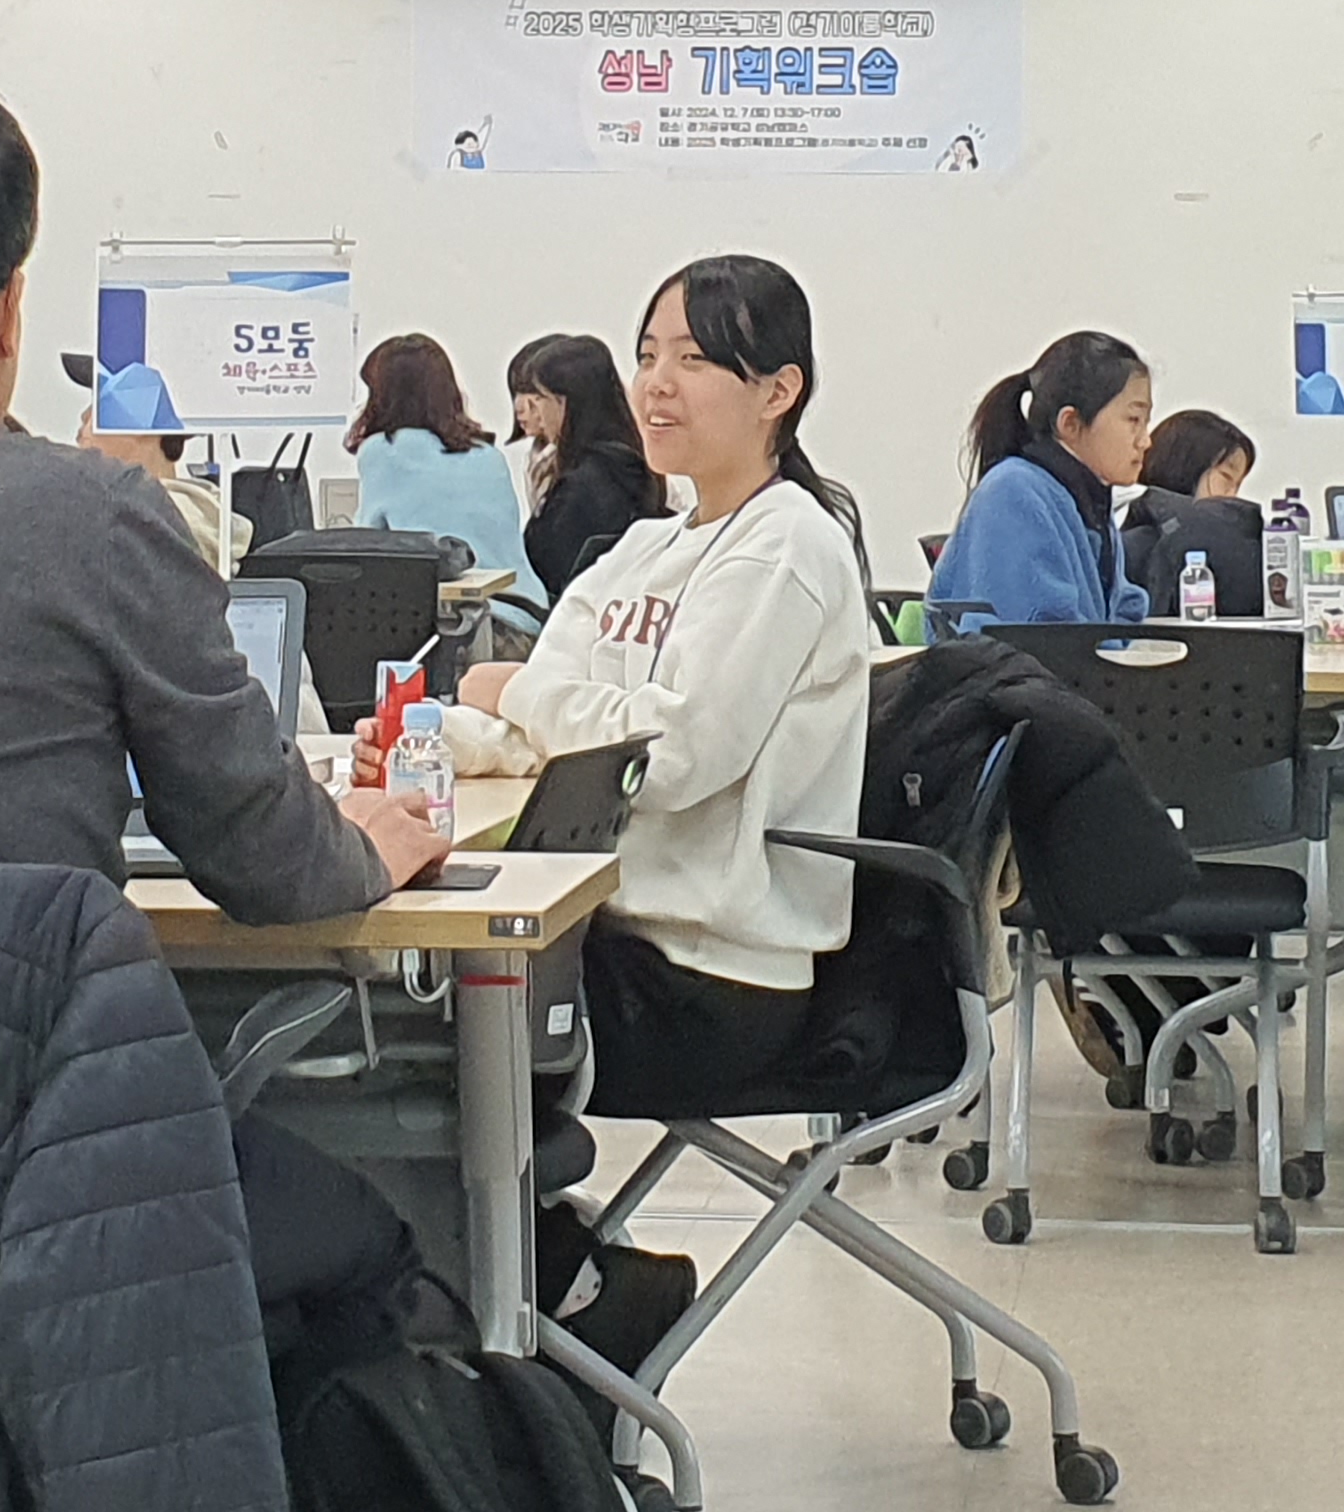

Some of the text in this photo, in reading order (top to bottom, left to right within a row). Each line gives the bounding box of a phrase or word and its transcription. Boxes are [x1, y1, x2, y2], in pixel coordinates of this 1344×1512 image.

[523, 11, 583, 36] 2025
[598, 45, 899, 95] 성남 기획워크숍
[233, 322, 315, 359] 5모둠
